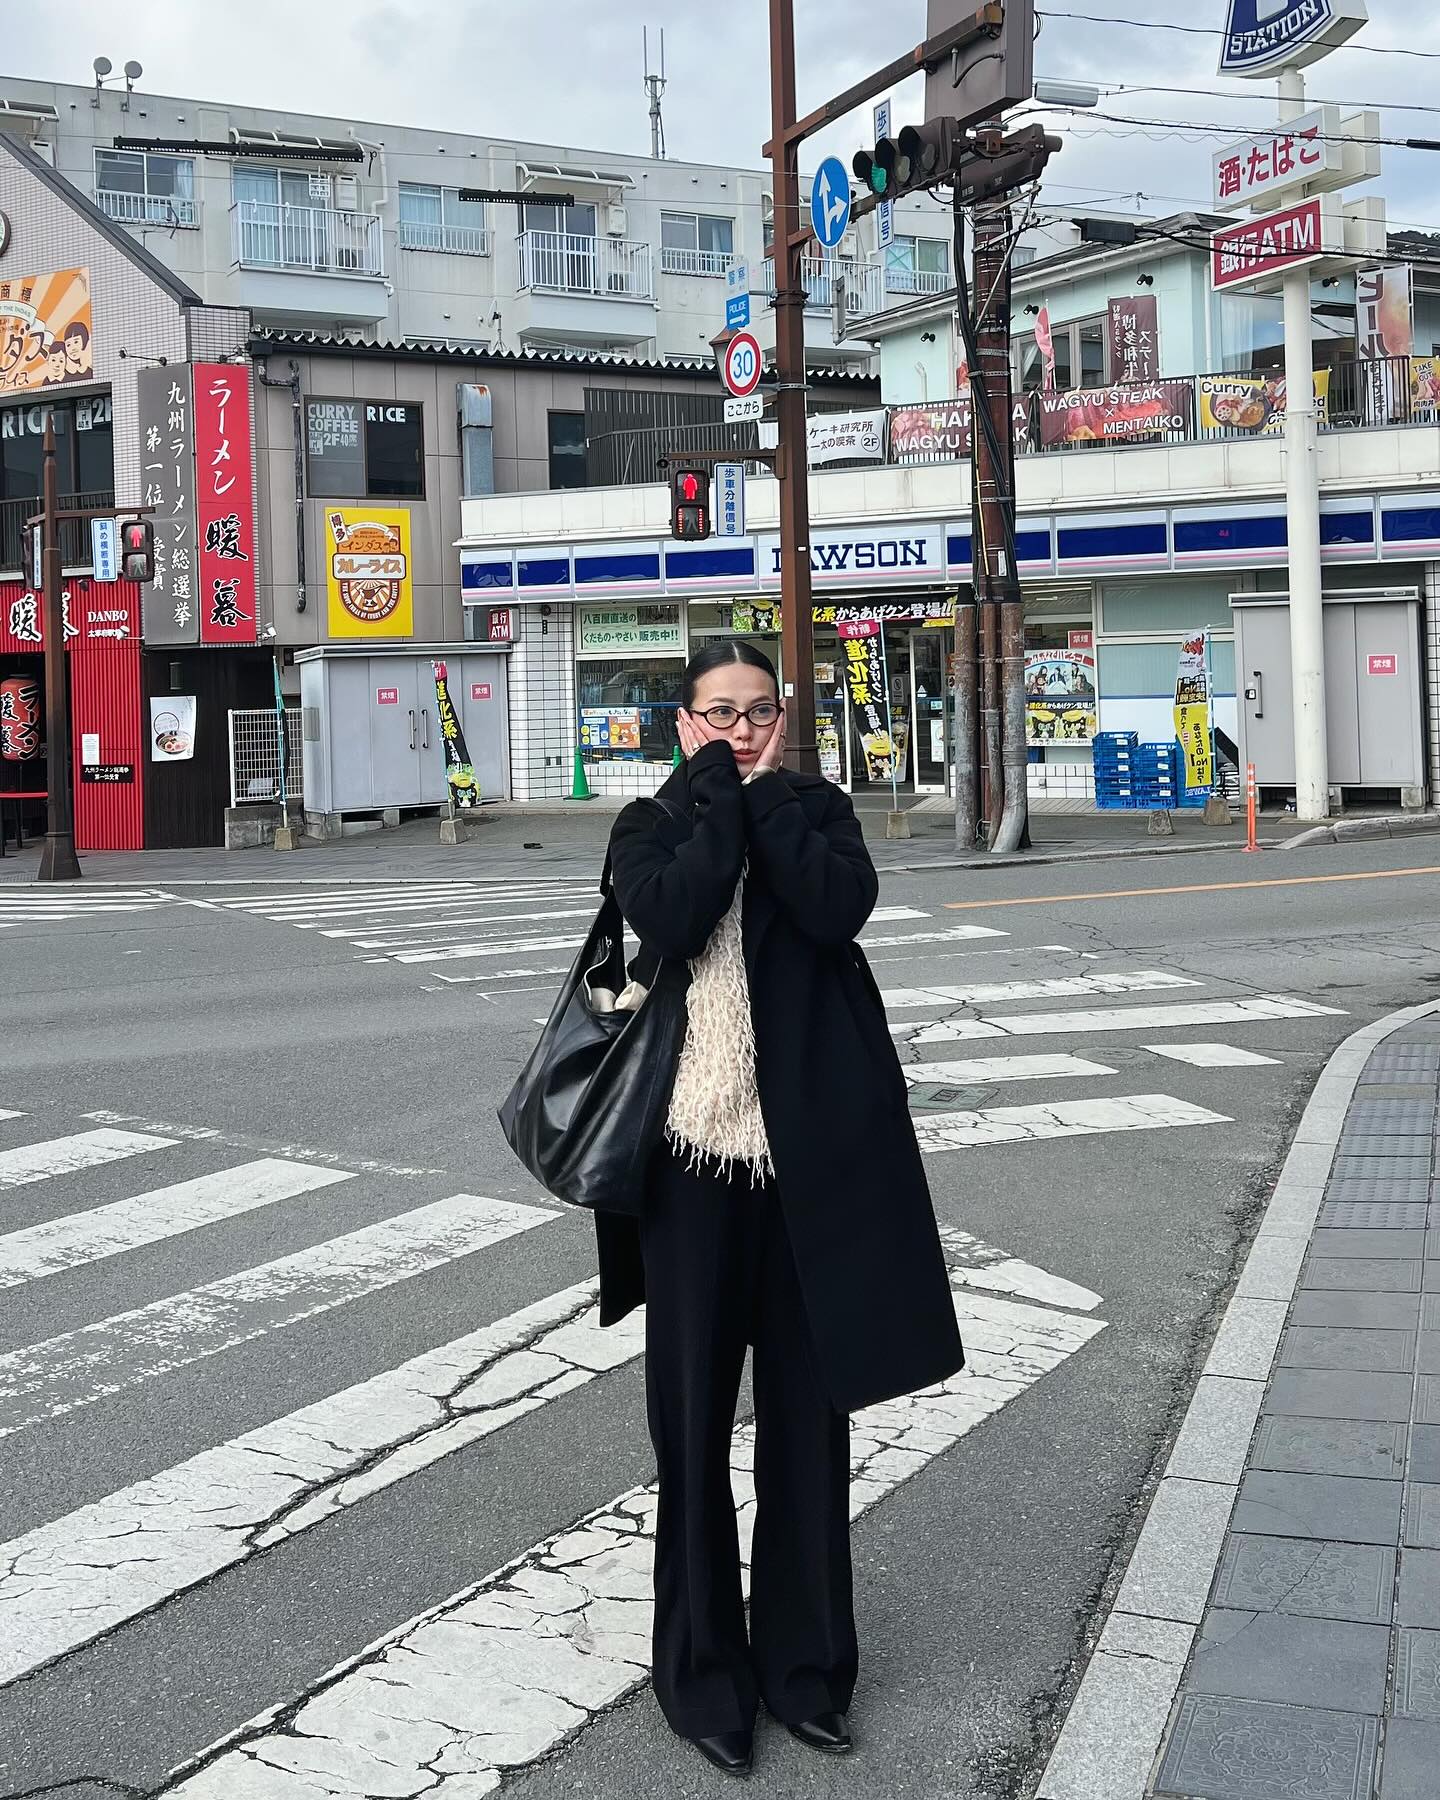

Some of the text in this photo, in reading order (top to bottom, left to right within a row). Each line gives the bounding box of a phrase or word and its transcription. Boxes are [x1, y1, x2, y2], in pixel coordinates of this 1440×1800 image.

[1230, 0, 1319, 56] STATION
[728, 300, 747, 315] POLICE
[733, 350, 754, 379] 30
[1413, 361, 1433, 373] TAKE
[1201, 381, 1251, 397] Curry
[1043, 387, 1164, 413] WAGYU STEAK
[307, 404, 355, 419] CURRY
[366, 406, 406, 423] RICE
[727, 401, 760, 417] ここから
[308, 418, 359, 433] COFFEE
[1103, 415, 1184, 435] MENTAIKO
[209, 379, 236, 495] ラーメン
[323, 432, 340, 446] 2F
[863, 437, 878, 447] 2F
[896, 434, 960, 453] WAGYU
[167, 381, 193, 628] 九州ラーメン総選挙
[724, 468, 736, 534] 歩車分離信号
[772, 539, 927, 573] WSON
[87, 610, 128, 623] DANBO
[491, 613, 508, 624] 銀行
[583, 611, 637, 625] 八百屋直送の
[491, 625, 509, 639] ATM
[583, 629, 679, 643] くだもの・やさい 販売中!!
[1372, 658, 1392, 669] 禁煙
